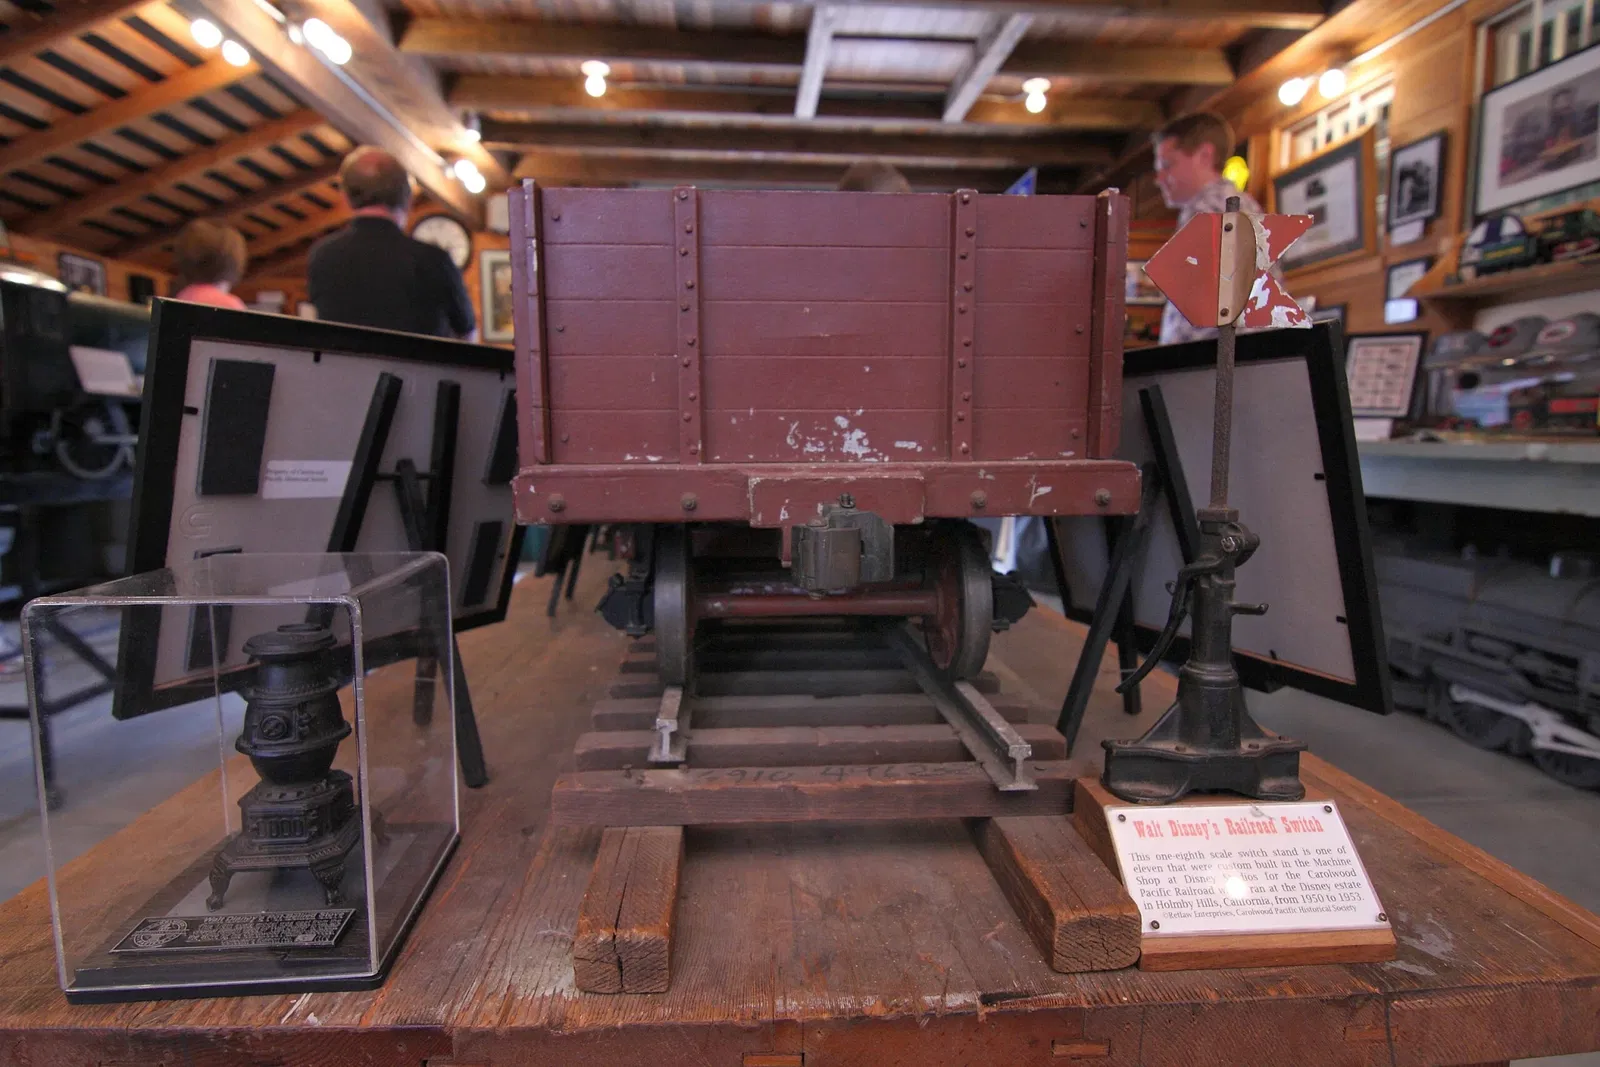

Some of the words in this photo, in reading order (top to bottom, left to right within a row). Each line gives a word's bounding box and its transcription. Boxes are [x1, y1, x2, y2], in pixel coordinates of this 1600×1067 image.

[1133, 820, 1164, 838] Walt
[1168, 819, 1220, 840] Disney's
[1224, 817, 1278, 836] Railroad
[1281, 816, 1324, 833] Switch
[1129, 852, 1150, 862] This
[1156, 850, 1205, 861] one-eighth
[1210, 849, 1233, 858] scale
[1238, 847, 1268, 857] switch
[1273, 847, 1298, 856] stand
[1302, 847, 1311, 855] is
[1337, 845, 1347, 854] of
[1133, 863, 1163, 873] eleven
[1167, 863, 1187, 872] that
[1218, 862, 1252, 870] custom
[1254, 859, 1278, 869] built
[1281, 860, 1291, 868] in
[1295, 858, 1310, 867] the
[1313, 857, 1352, 867] Machine
[1136, 876, 1160, 886] Shop
[1184, 874, 1216, 885] Disney
[1223, 873, 1258, 882] Sios
[1265, 871, 1279, 880] for
[1286, 871, 1301, 879] the
[1307, 868, 1357, 879] Carolwood
[1140, 887, 1172, 897] Pacific
[1174, 886, 1215, 896] Railroad
[1249, 885, 1265, 893] ran
[1281, 883, 1296, 892] the
[1299, 882, 1331, 891] Disney
[1334, 881, 1362, 889] estate
[1144, 901, 1153, 910] in
[1156, 900, 1193, 910] Holmby
[1196, 898, 1222, 908] Hills,
[1223, 896, 1273, 907] California,
[1275, 895, 1298, 904] from
[1301, 894, 1324, 903] 1950
[1326, 894, 1336, 902] to
[1339, 892, 1364, 901] 1953.
[1194, 910, 1235, 918] Enterprises,
[1236, 908, 1273, 916] Carolwood
[1299, 905, 1331, 913] Historical
[1332, 904, 1357, 912] Society
